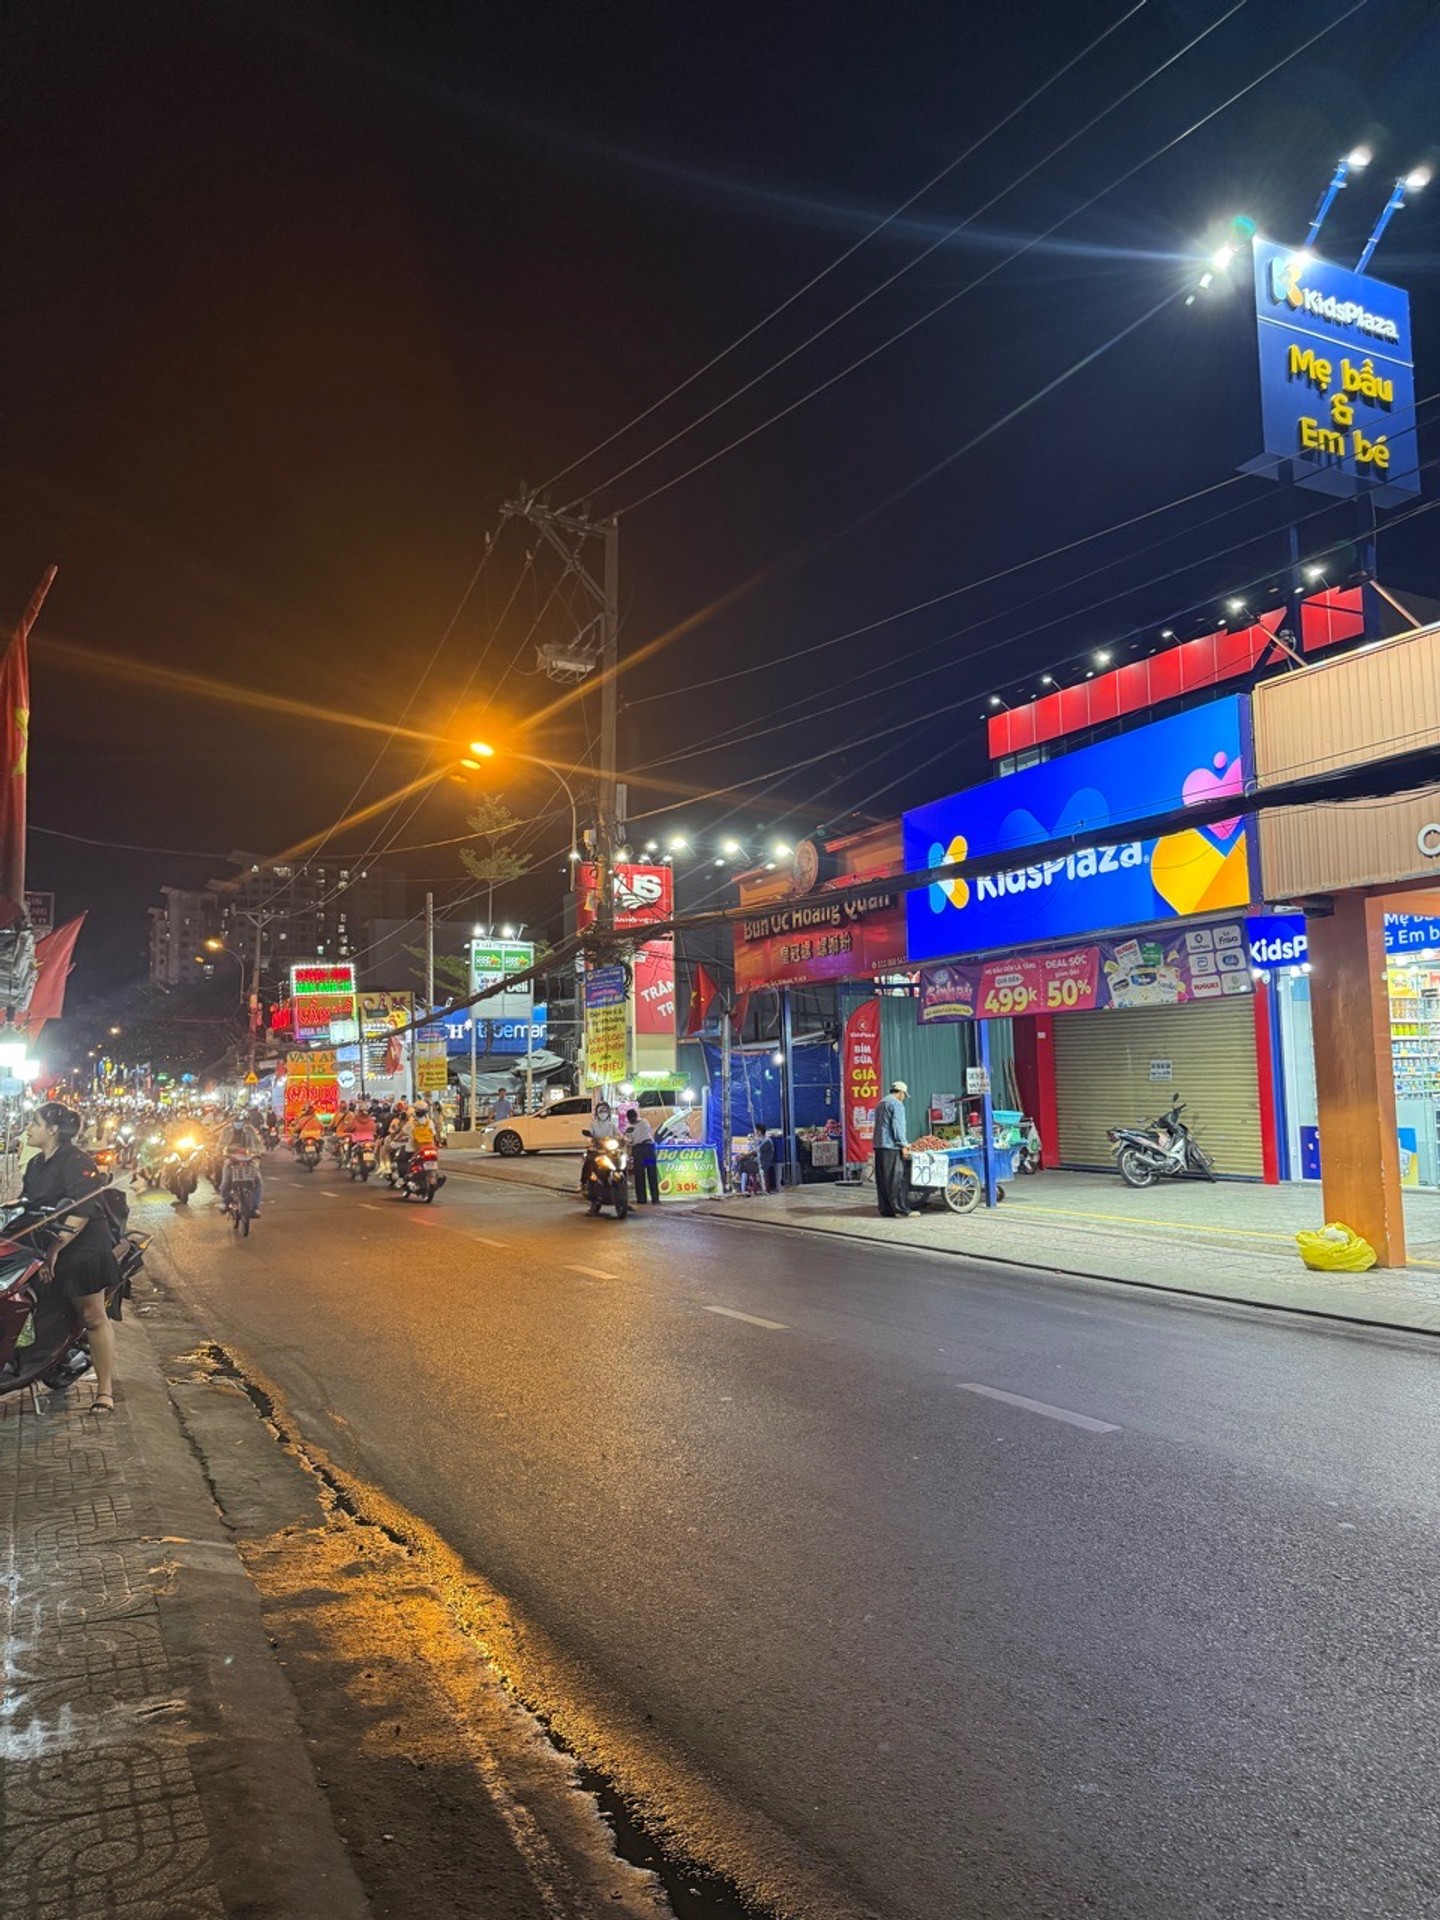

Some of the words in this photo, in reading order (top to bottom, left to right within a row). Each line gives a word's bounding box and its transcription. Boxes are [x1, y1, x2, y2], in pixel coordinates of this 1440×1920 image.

[1302, 287, 1399, 339] KidsPlaza
[1288, 344, 1332, 390] Mẹ
[1330, 393, 1354, 425] &
[1299, 416, 1345, 456] Em
[1353, 430, 1390, 468] bé
[1398, 930, 1429, 945] Em
[1045, 958, 1068, 969] DEAL
[1047, 977, 1092, 1008] 50%
[852, 1065, 876, 1081] GIÁ
[851, 1081, 878, 1098] TỐT
